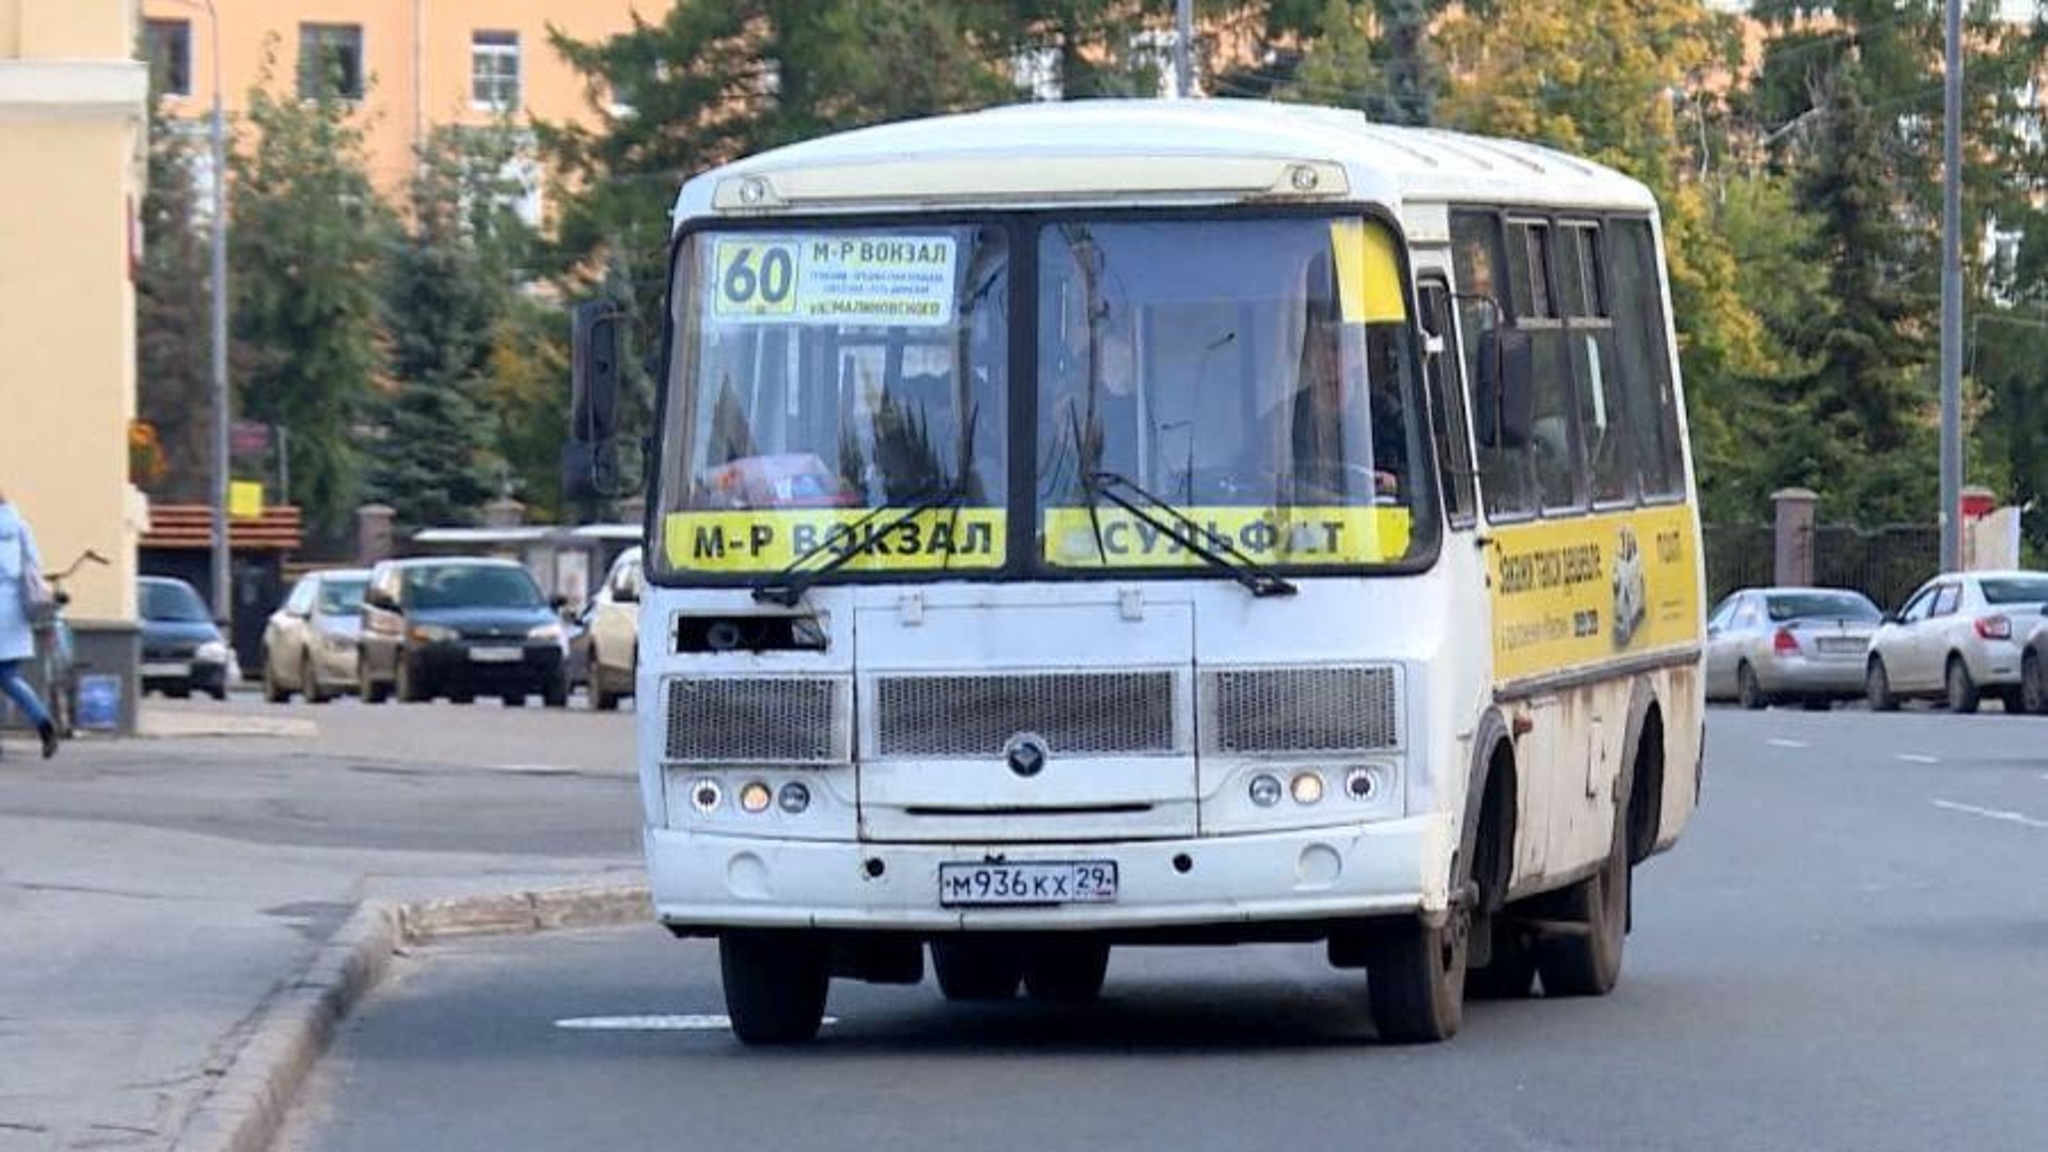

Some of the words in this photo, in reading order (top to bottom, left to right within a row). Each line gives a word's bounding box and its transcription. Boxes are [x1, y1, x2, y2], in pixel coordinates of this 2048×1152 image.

[813, 242, 854, 264] М-Р
[861, 241, 947, 264] ВОКЗАЛ
[723, 246, 793, 304] 60
[692, 526, 776, 560] М-Р
[792, 522, 992, 559] ВОКЗАЛ
[1103, 518, 1347, 558] СУЛЬФАТ
